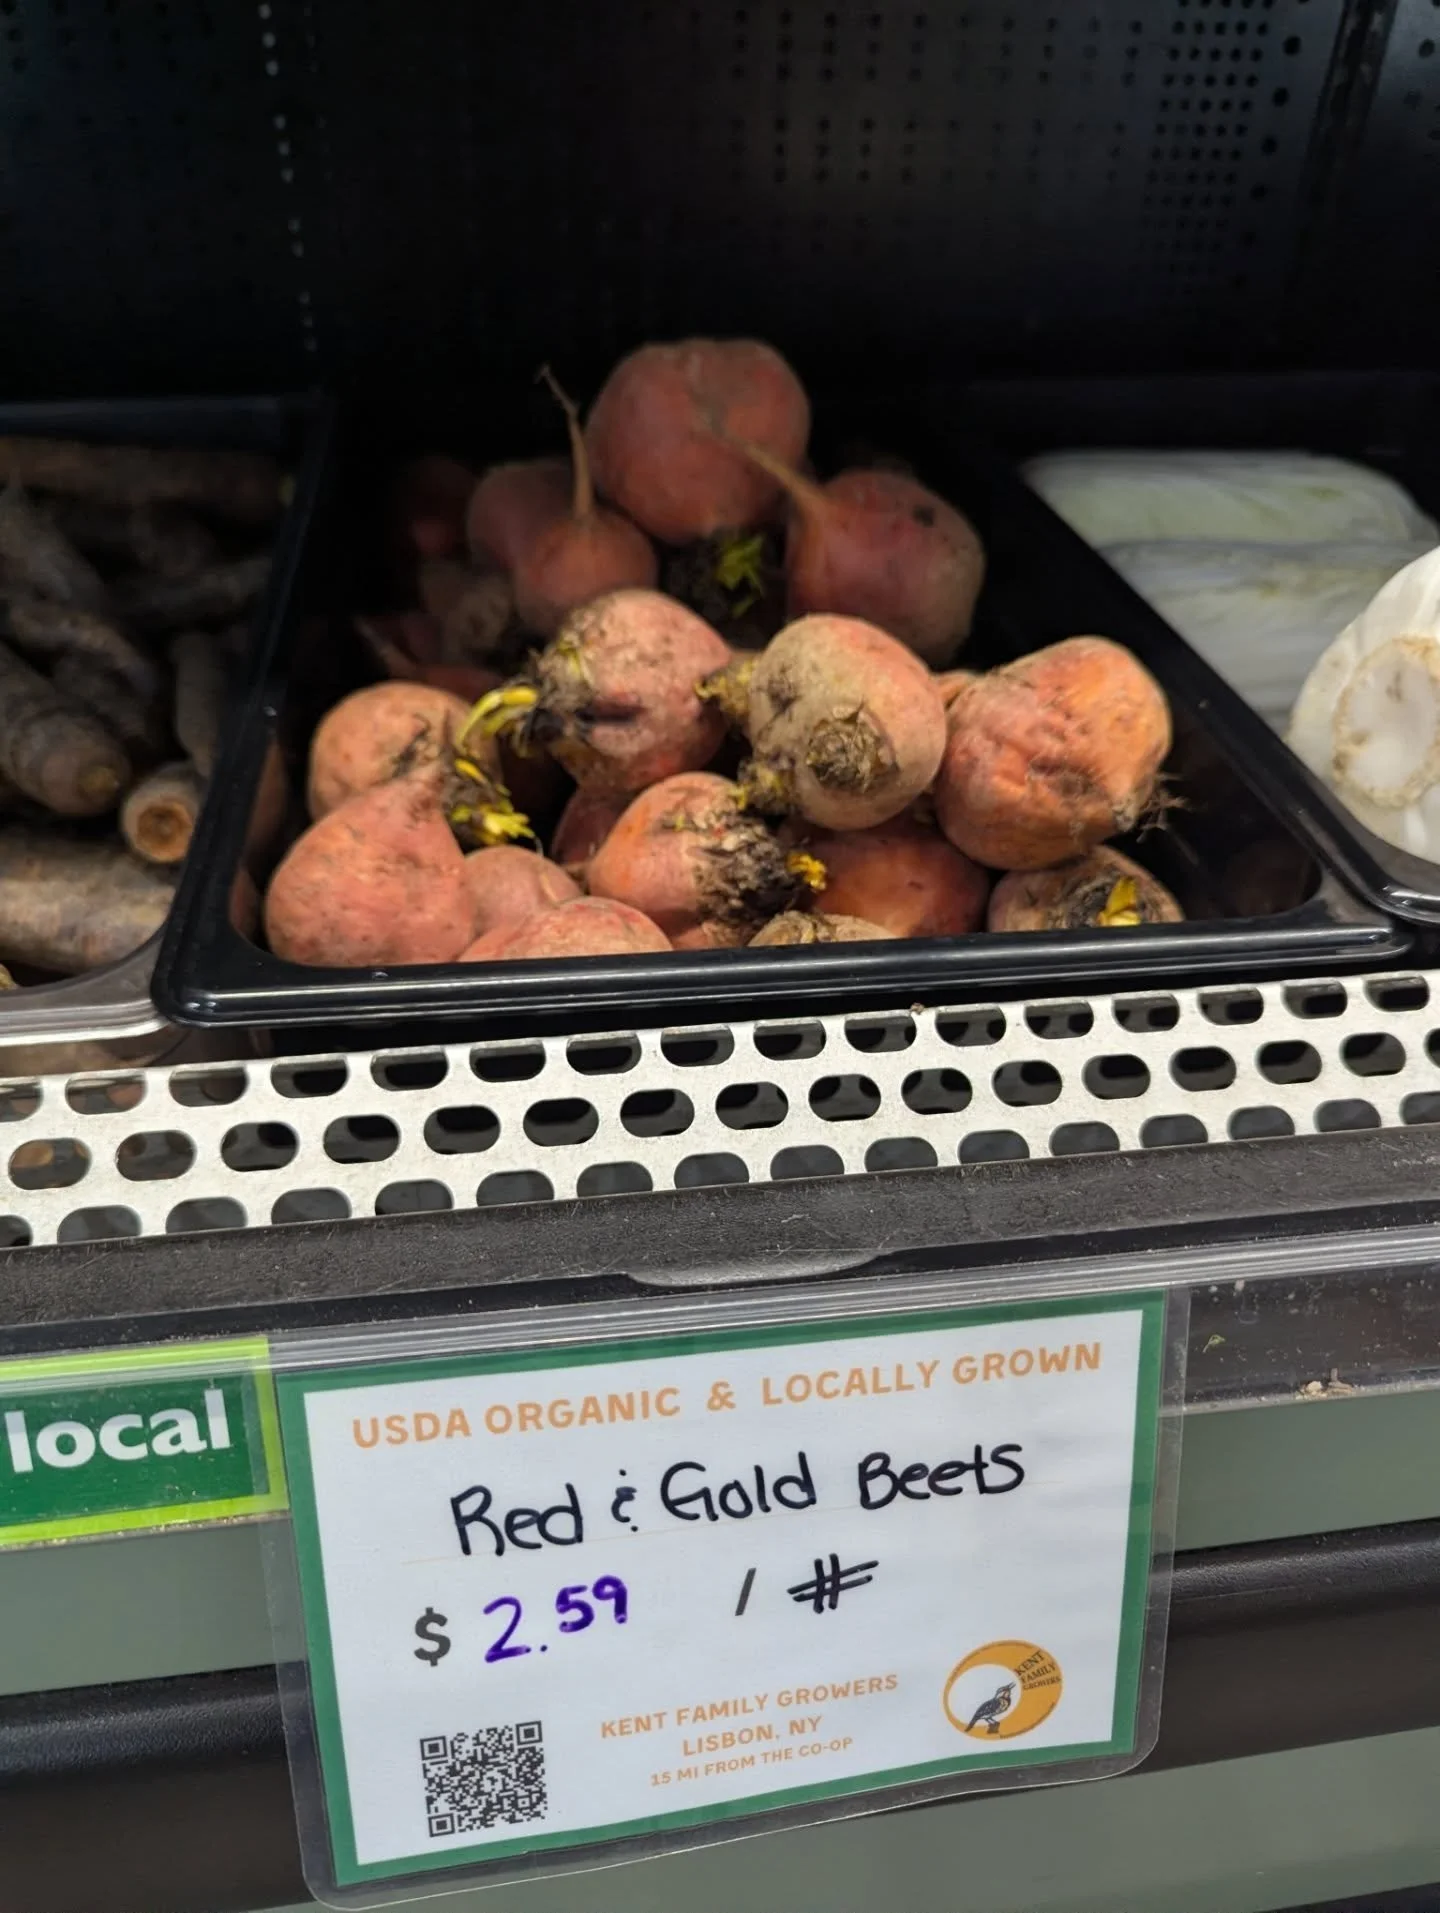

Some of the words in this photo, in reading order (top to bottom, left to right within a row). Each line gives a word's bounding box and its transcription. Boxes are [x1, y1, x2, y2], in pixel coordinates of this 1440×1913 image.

[4, 1388, 231, 1473] local
[353, 1408, 472, 1448] USDA
[485, 1387, 680, 1434] ORGANIC
[707, 1381, 736, 1412] &
[762, 1360, 940, 1406] LOCALLY
[952, 1342, 1101, 1384] GROWN
[450, 1483, 583, 1556] Red
[660, 1451, 816, 1521] Gold
[858, 1444, 1025, 1510] Beets
[414, 1607, 451, 1667] $
[483, 1575, 627, 1662] 2.59
[601, 1711, 668, 1738] KENT
[676, 1693, 769, 1726] FAMILY
[777, 1674, 898, 1708] GROWERS
[789, 1714, 824, 1736] NY
[651, 1771, 673, 1786] 15
[677, 1767, 698, 1781] MI
[704, 1755, 756, 1776] FROM
[761, 1748, 793, 1764] THE
[799, 1737, 853, 1757] CO-OP
